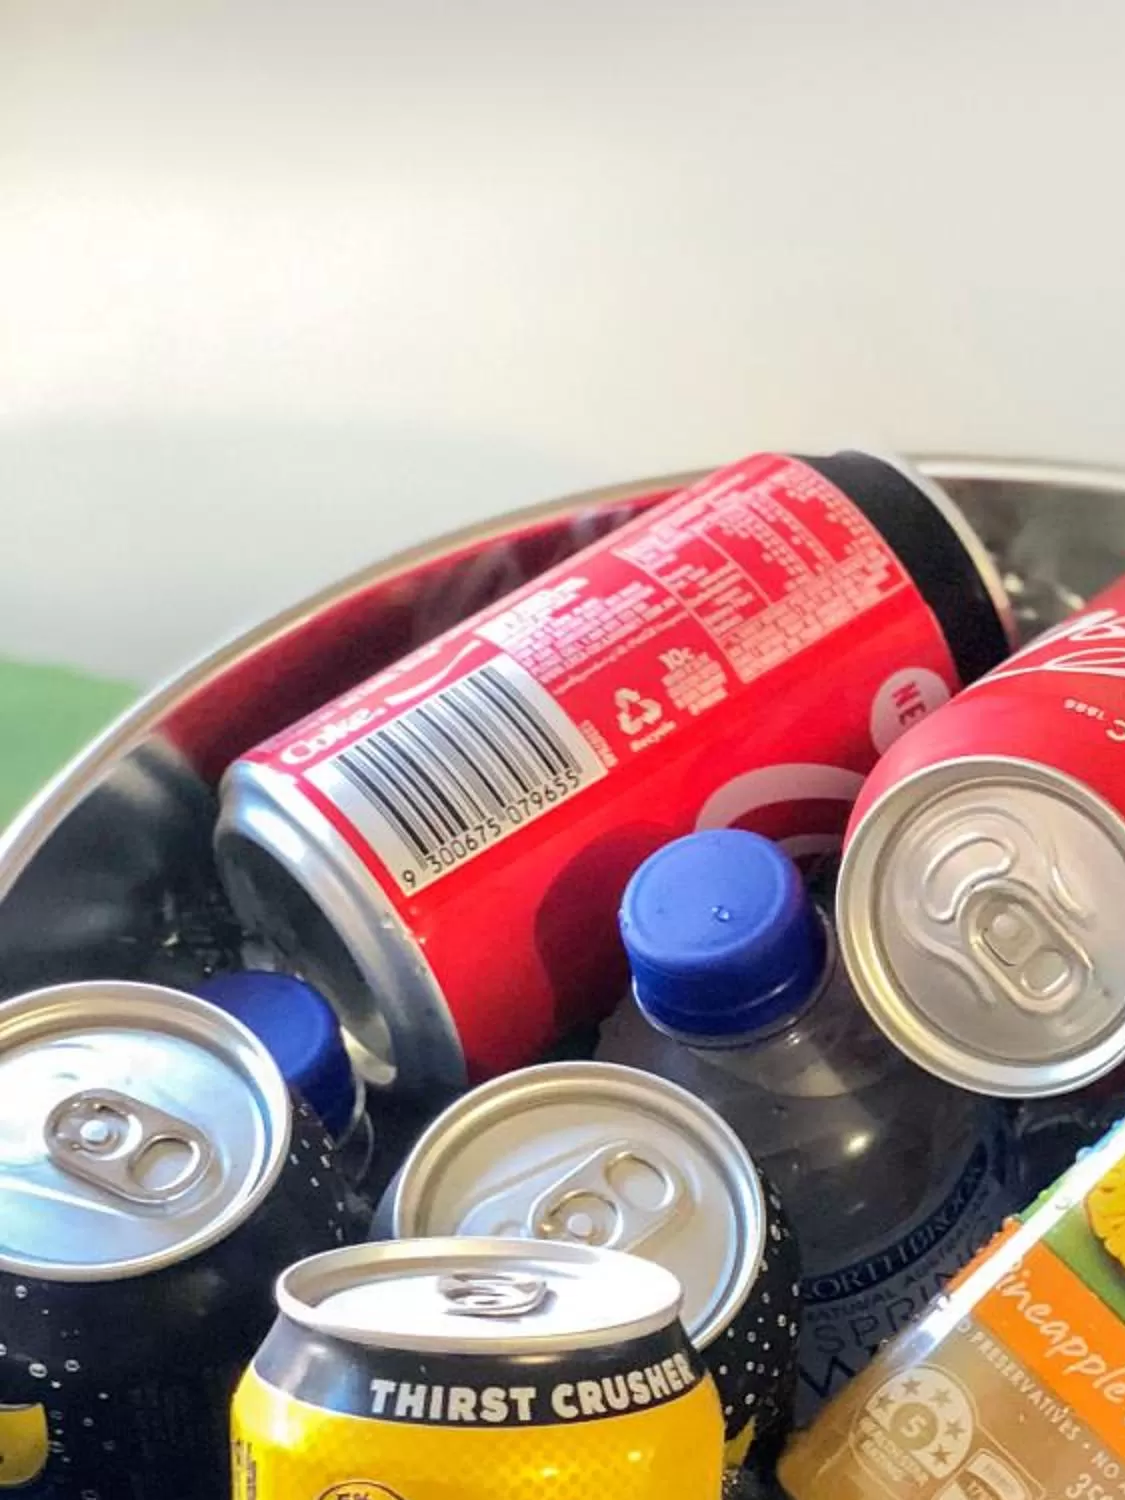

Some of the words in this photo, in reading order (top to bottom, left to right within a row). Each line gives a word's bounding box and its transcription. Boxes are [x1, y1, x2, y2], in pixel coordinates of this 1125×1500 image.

[891, 681, 927, 726] NE
[402, 869, 417, 889] 9
[426, 818, 502, 874] 300675
[506, 769, 581, 825] 079655
[370, 1379, 537, 1422] THIRST
[551, 1353, 697, 1419] CRUSHER
[967, 1329, 1081, 1442] PRESERVATIVES
[1091, 1450, 1120, 1479] NO
